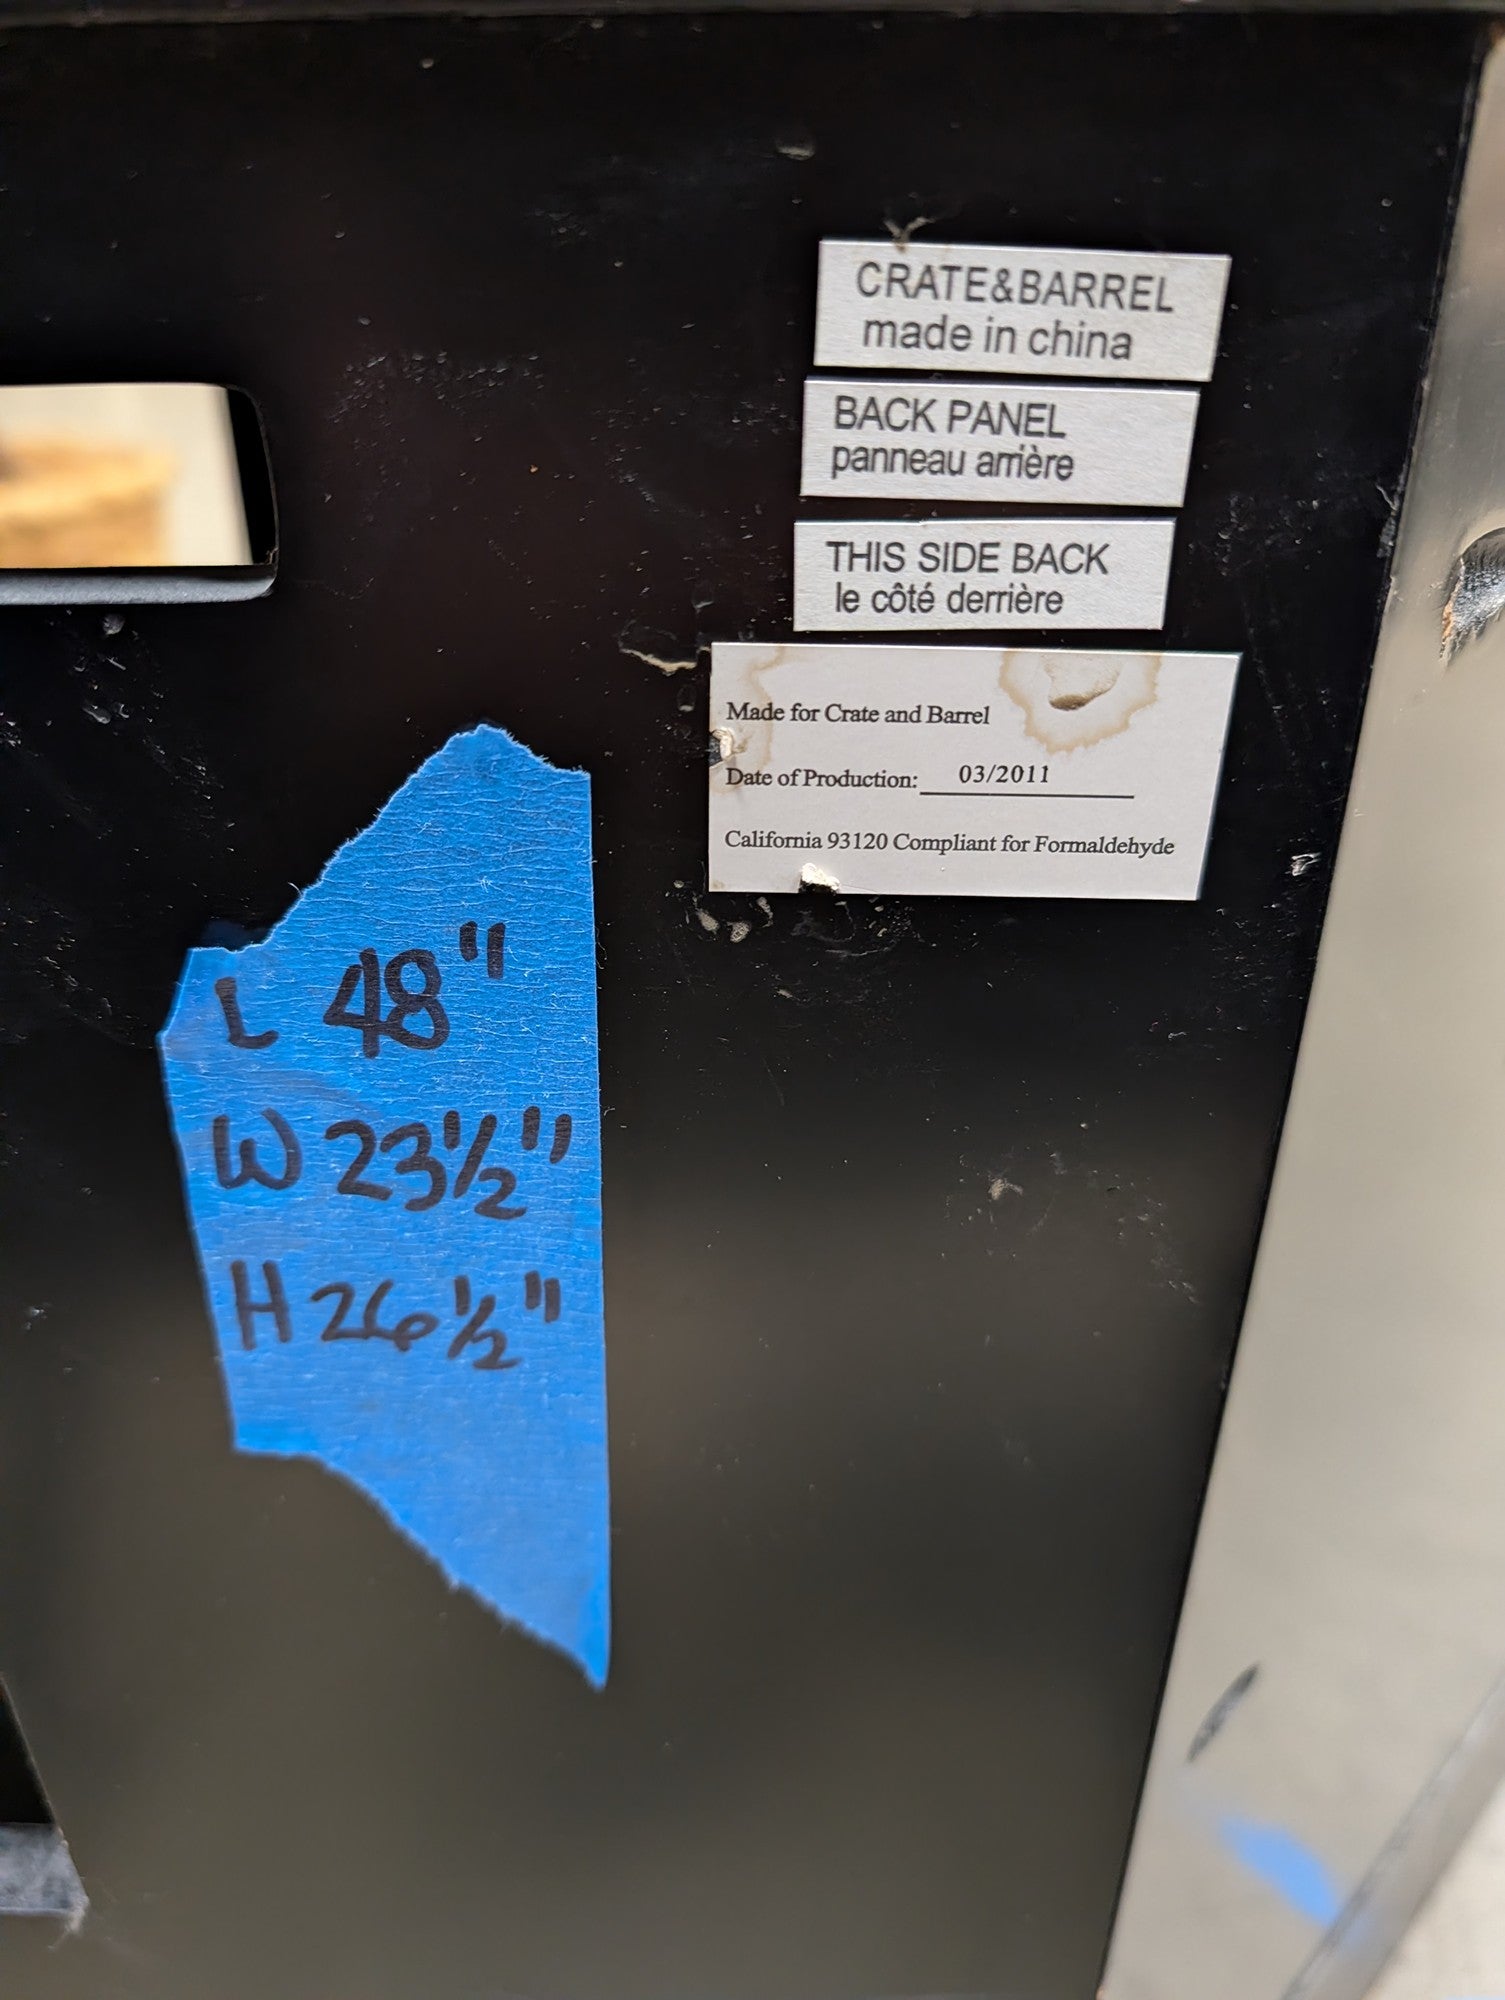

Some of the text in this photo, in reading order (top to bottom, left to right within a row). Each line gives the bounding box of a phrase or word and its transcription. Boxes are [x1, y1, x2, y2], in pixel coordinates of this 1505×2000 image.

[856, 261, 1175, 313] CRATE&BARREL
[863, 314, 1133, 360] made in china
[834, 394, 1067, 439] BACK PANEL
[831, 443, 1074, 482] panneau arrière
[825, 540, 1110, 575] THIS SIDE BACK
[835, 581, 1064, 615] le côté derrière
[726, 701, 990, 725] Made for Crate and Barrel
[725, 764, 1049, 789] Date of Production: 03/2011
[724, 830, 1175, 859] California 93120 Compliant for Formaldehyde
[214, 977, 279, 1049] L
[213, 1108, 301, 1190] W
[231, 1261, 292, 1351] H
